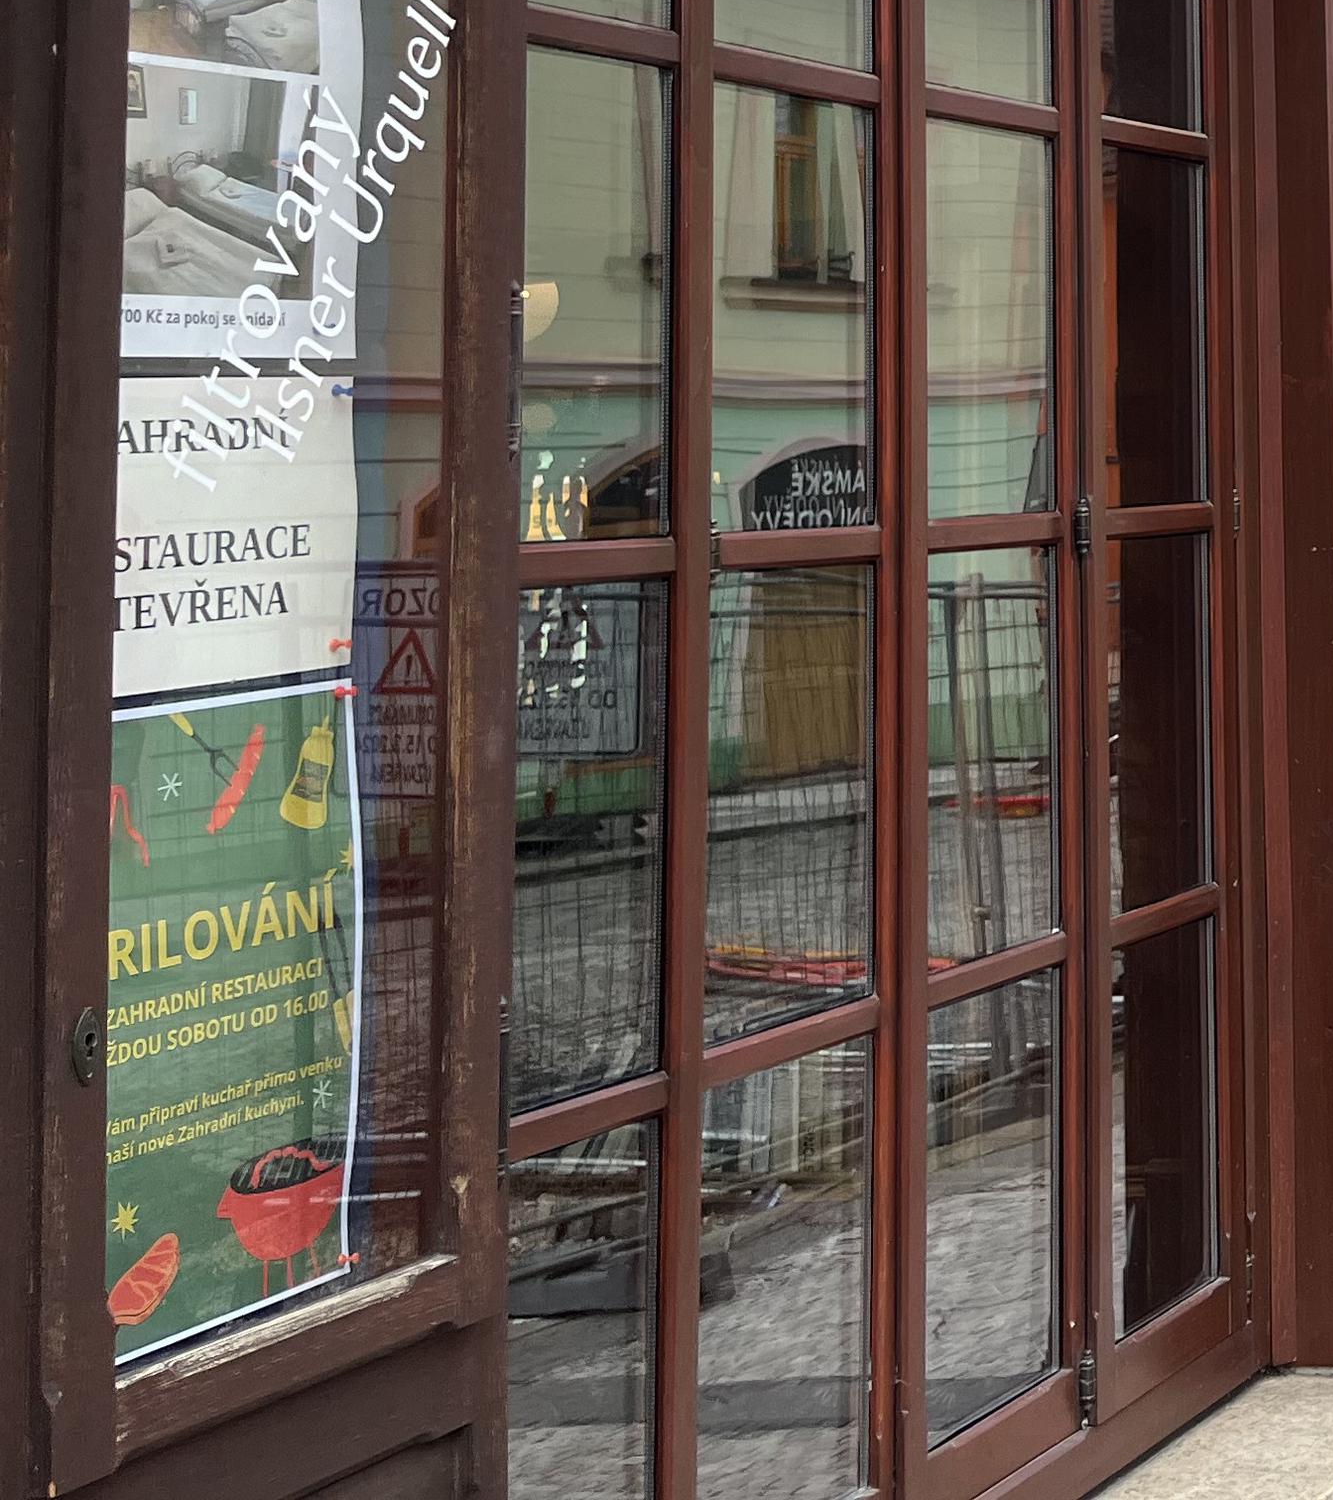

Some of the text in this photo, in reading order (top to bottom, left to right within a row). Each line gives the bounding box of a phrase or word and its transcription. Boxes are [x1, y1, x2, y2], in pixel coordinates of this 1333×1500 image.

[146, 308, 163, 324] Kč
[166, 312, 181, 325] za
[184, 310, 220, 329] pokoj
[222, 313, 236, 326] se
[240, 311, 286, 326] nídaí
[163, 87, 361, 493] filtrovaný
[114, 523, 311, 573] STAURACE
[108, 868, 338, 981] RILOVÁNÍ
[107, 957, 323, 1030] ZAHRADNÍ RESTAURACI
[106, 989, 329, 1068] ŽDOU SOBOTU OD 16.00
[201, 1077, 253, 1107] kuchař
[254, 1070, 296, 1100] přímo
[299, 1054, 343, 1079] venku
[138, 1128, 175, 1156] nové
[178, 1104, 242, 1143] Zahradní
